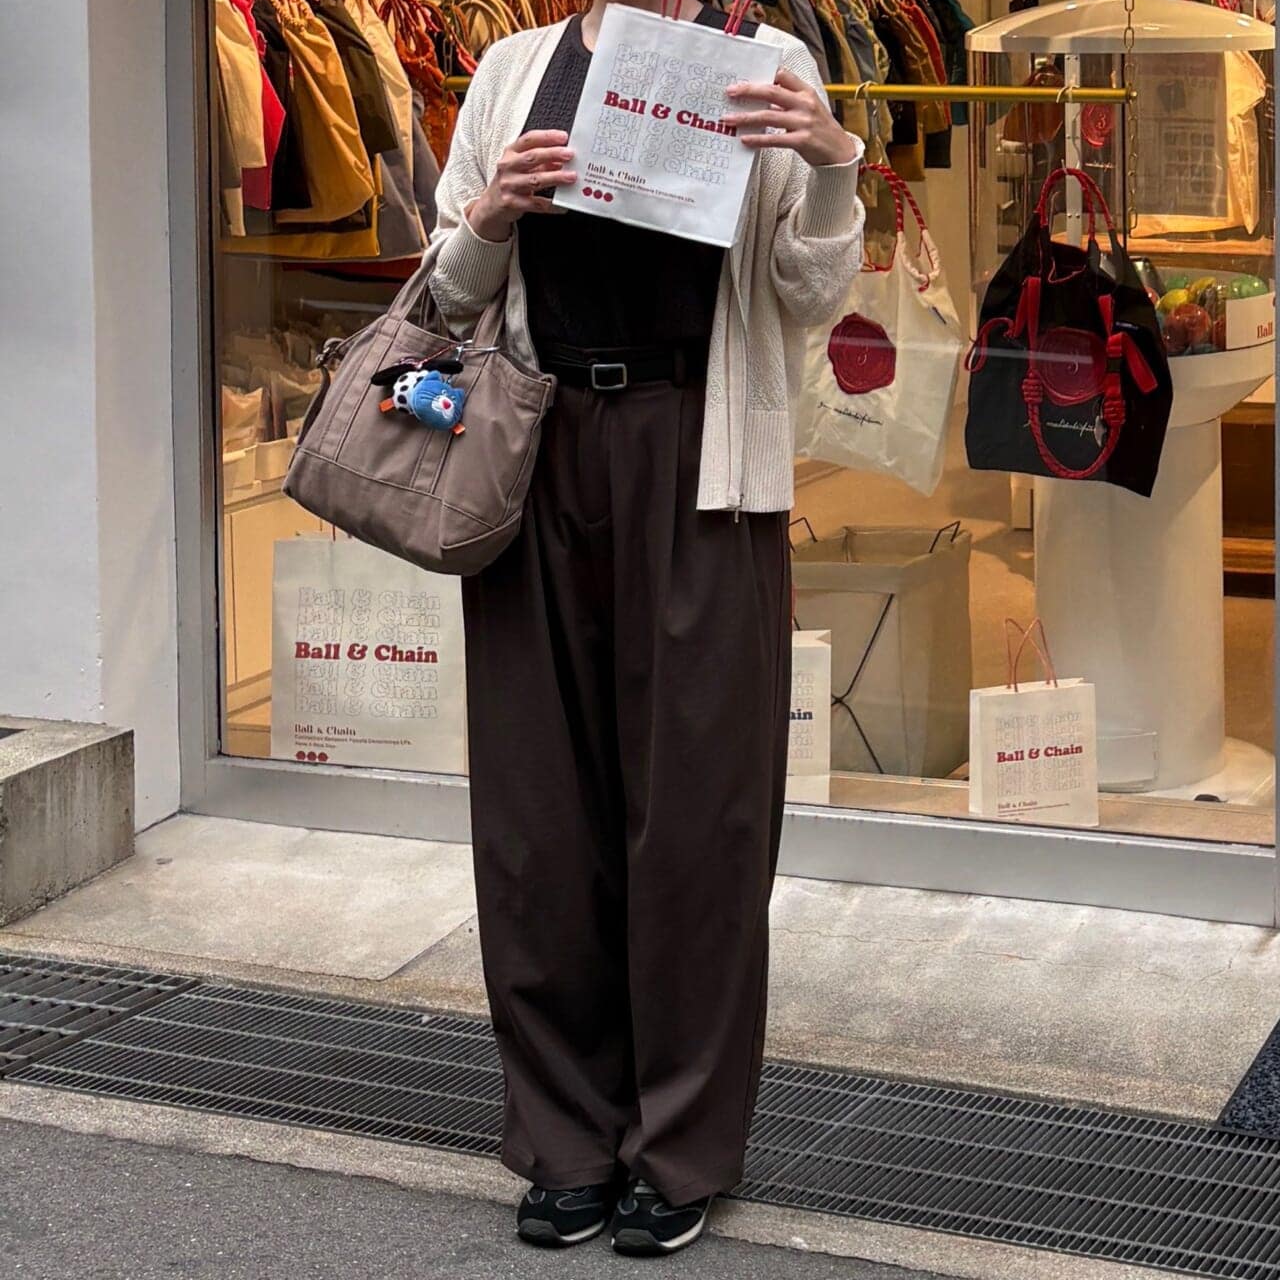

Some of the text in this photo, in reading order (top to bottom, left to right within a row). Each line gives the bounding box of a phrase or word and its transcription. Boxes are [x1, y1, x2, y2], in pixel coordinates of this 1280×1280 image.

[603, 90, 737, 137] Ball & Chain
[617, 171, 647, 185] Chain
[295, 642, 438, 663] Ball & Chain
[789, 709, 813, 720] ain
[326, 726, 356, 736] Chain
[997, 744, 1083, 763] Ball & Chain
